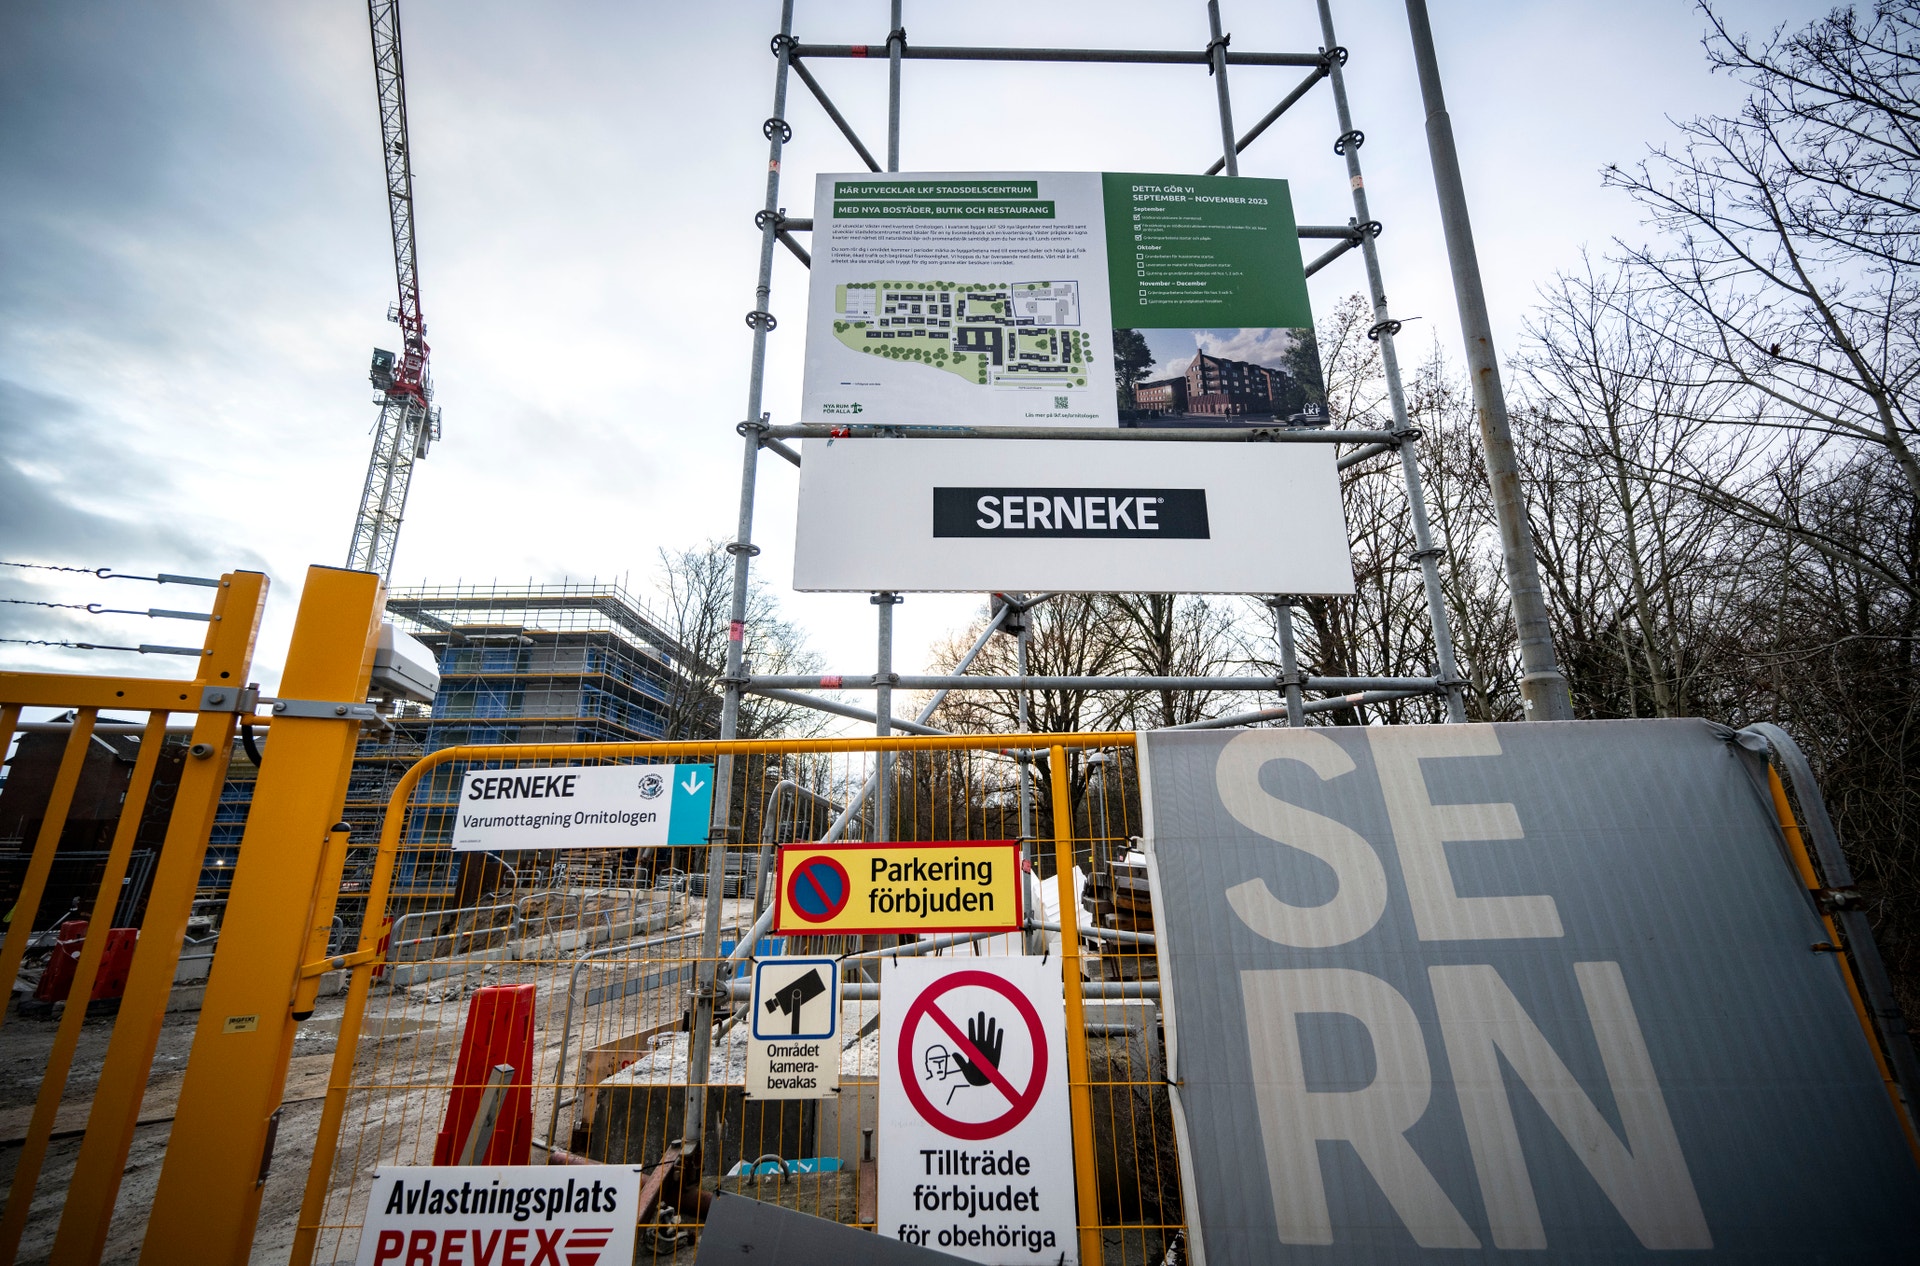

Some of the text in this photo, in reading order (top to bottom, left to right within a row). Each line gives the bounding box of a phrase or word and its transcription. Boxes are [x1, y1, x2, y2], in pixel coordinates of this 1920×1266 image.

[840, 186, 859, 194] HÄR
[1163, 184, 1183, 193] GÖR
[882, 205, 934, 214] BOSTÄDER,
[1195, 196, 1246, 204] NOVEMBER
[462, 810, 656, 829] Varumottagning Ornitologen
[871, 856, 992, 886] Parkering
[868, 887, 994, 918] förbjuden
[767, 1042, 820, 1057] Området
[770, 1060, 818, 1072] kamera-
[768, 1075, 816, 1089] bevakas
[920, 1150, 1030, 1175] Tillträde
[384, 1178, 617, 1221] Avlastningsplats
[913, 1184, 1039, 1218] förbjudet
[373, 1228, 565, 1266] PREVEX
[898, 1224, 1056, 1253] för obehöriga
